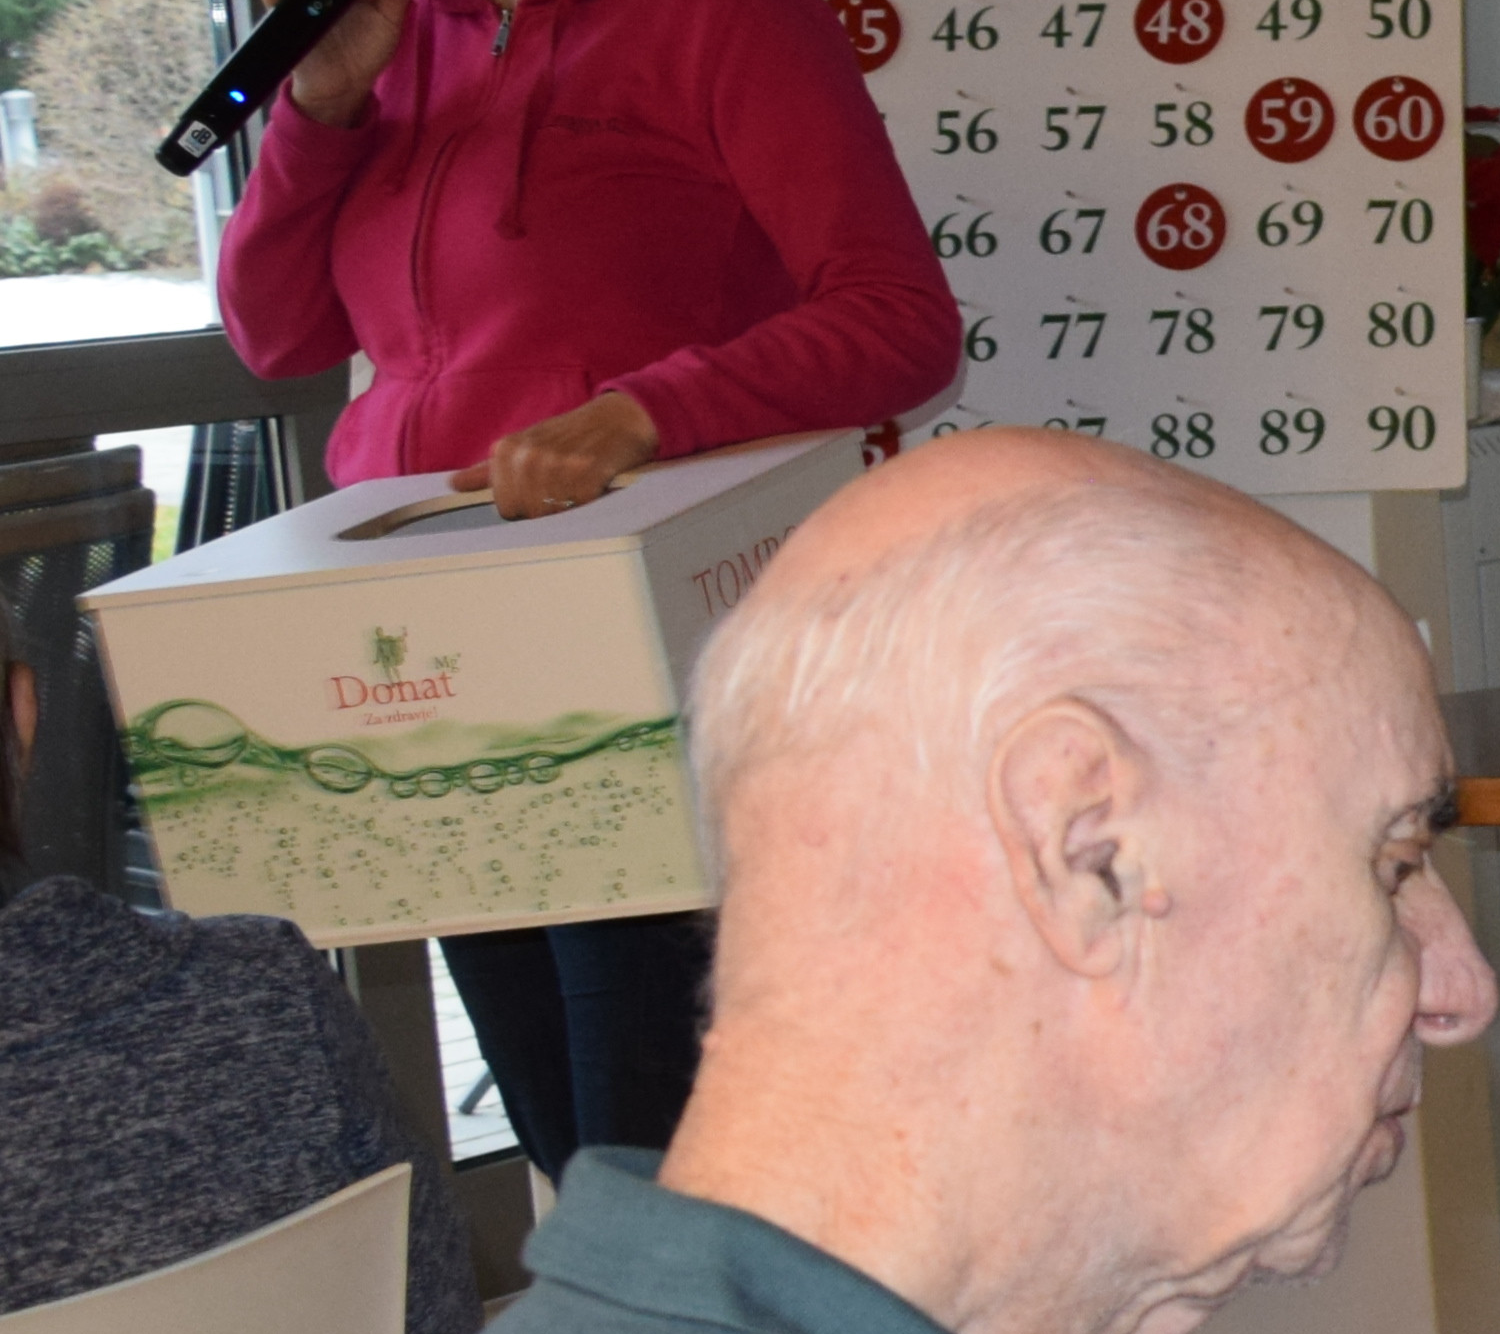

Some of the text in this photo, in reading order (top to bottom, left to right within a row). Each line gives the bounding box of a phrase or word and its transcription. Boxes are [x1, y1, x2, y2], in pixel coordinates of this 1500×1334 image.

[931, 5, 999, 52] 46
[1039, 2, 1107, 49] 47
[930, 95, 1434, 155] 56 57 58 59 60
[930, 198, 1434, 258] 66 67 68 69 70
[1040, 312, 1107, 360] 77
[1150, 307, 1216, 356] 78
[1259, 303, 1325, 352] 79
[1367, 301, 1436, 348] 80
[1150, 412, 1216, 460] 88
[1259, 408, 1326, 456] 89
[1367, 405, 1437, 451] 90
[329, 671, 458, 709] Donat
